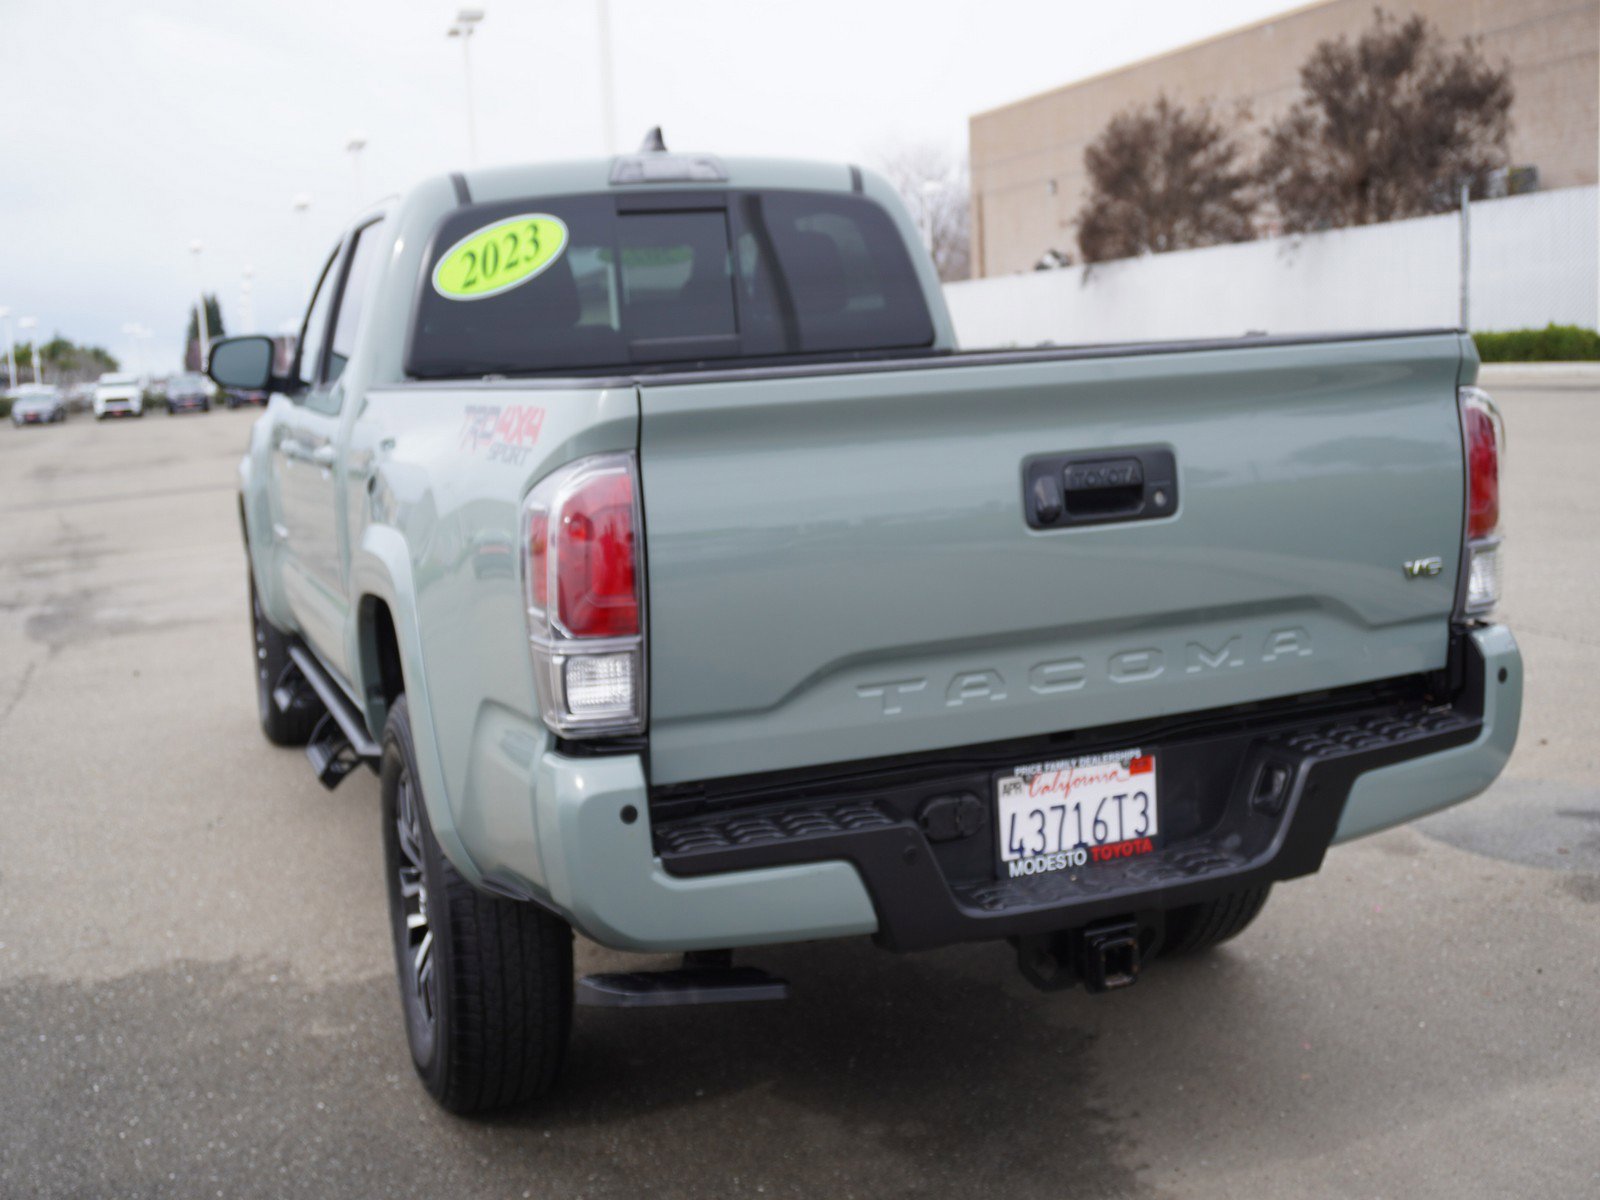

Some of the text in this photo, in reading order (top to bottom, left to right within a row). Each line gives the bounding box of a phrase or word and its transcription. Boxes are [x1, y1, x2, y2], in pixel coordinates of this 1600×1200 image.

[460, 222, 541, 290] 2023
[486, 440, 532, 465] SPORT
[1402, 556, 1442, 580] V6
[855, 624, 1313, 715] TACOMA
[1045, 758, 1078, 773] FAMILY
[1002, 781, 1022, 797] APR
[1028, 768, 1130, 798] California
[1008, 791, 1149, 859] 43716T3
[1008, 837, 1153, 878] MODESTO TOYOTA
